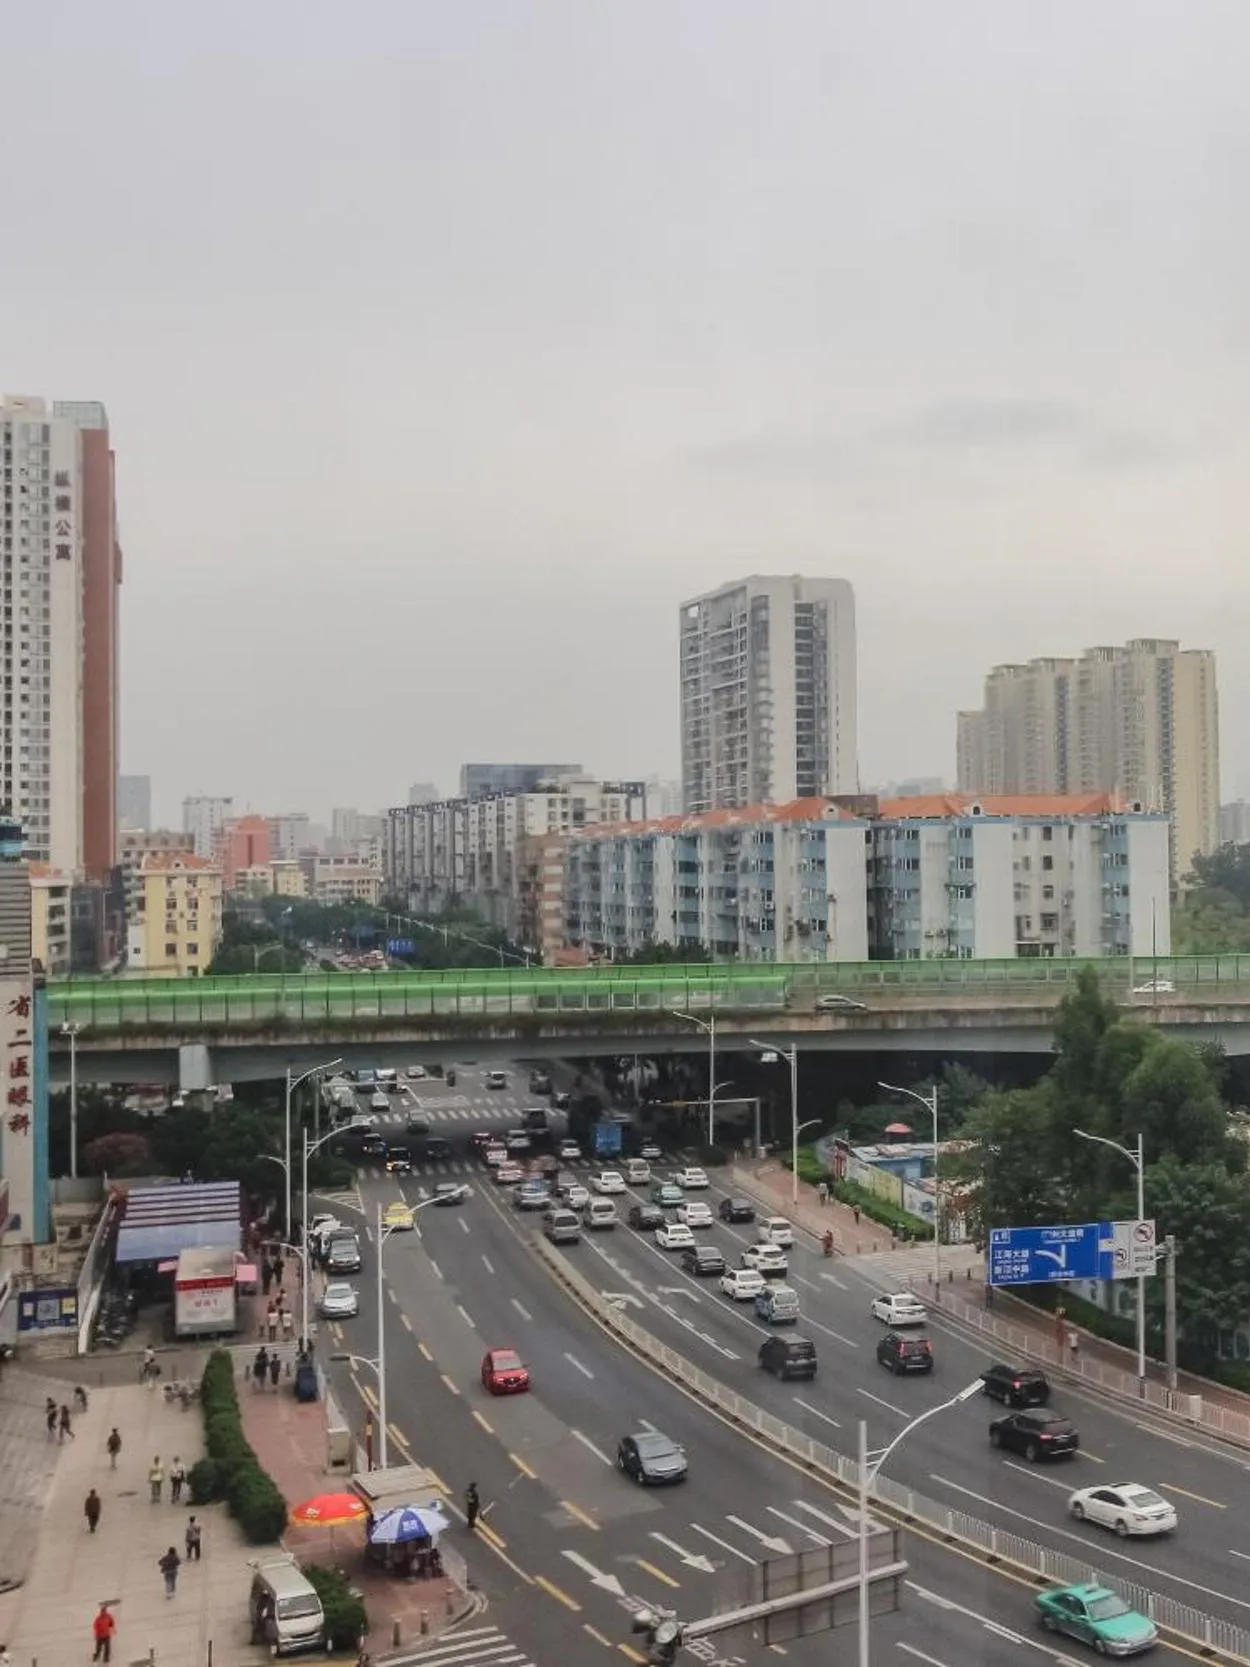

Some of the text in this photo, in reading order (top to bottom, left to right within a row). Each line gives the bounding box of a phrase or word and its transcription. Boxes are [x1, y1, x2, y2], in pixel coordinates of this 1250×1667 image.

[7, 995, 32, 1136] 省二医眼科
